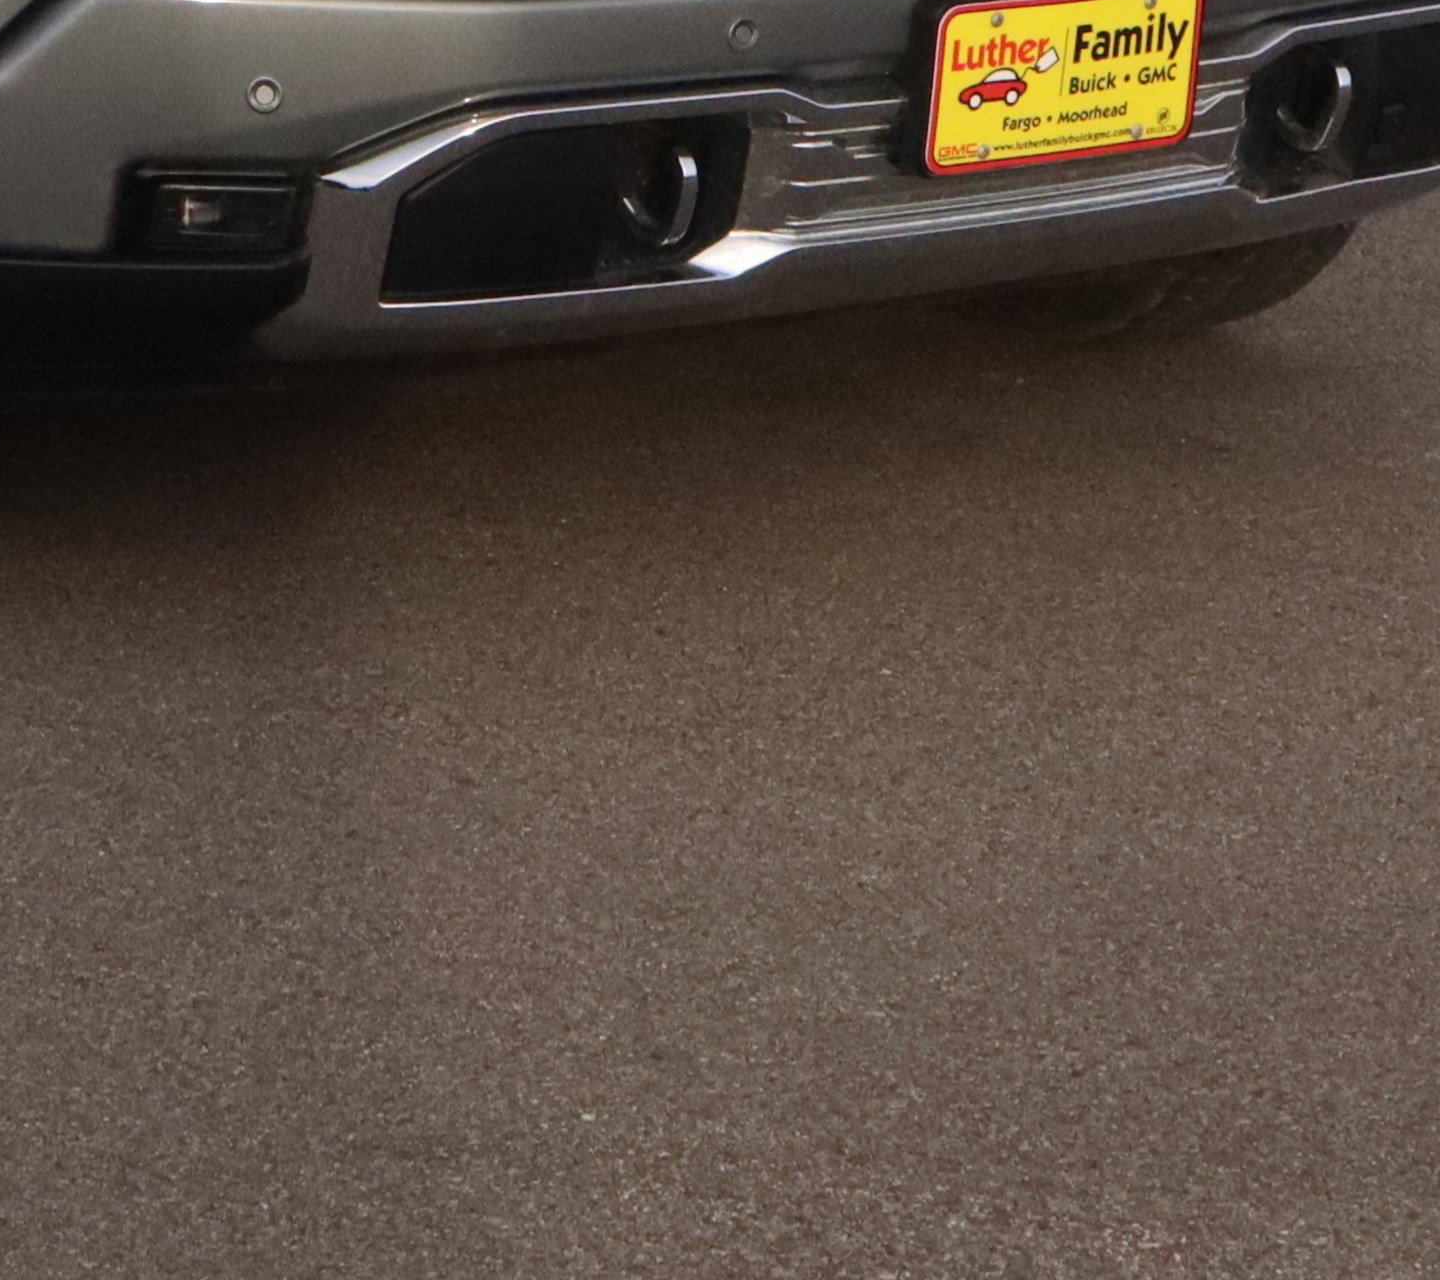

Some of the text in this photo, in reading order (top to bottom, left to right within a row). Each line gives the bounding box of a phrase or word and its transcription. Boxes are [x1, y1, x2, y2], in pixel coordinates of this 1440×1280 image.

[951, 33, 1051, 72] Luther
[1072, 11, 1189, 64] Family
[1069, 62, 1178, 95] Buick GMC
[1002, 100, 1128, 132] Fargo Moorhead
[938, 143, 978, 158] GMC
